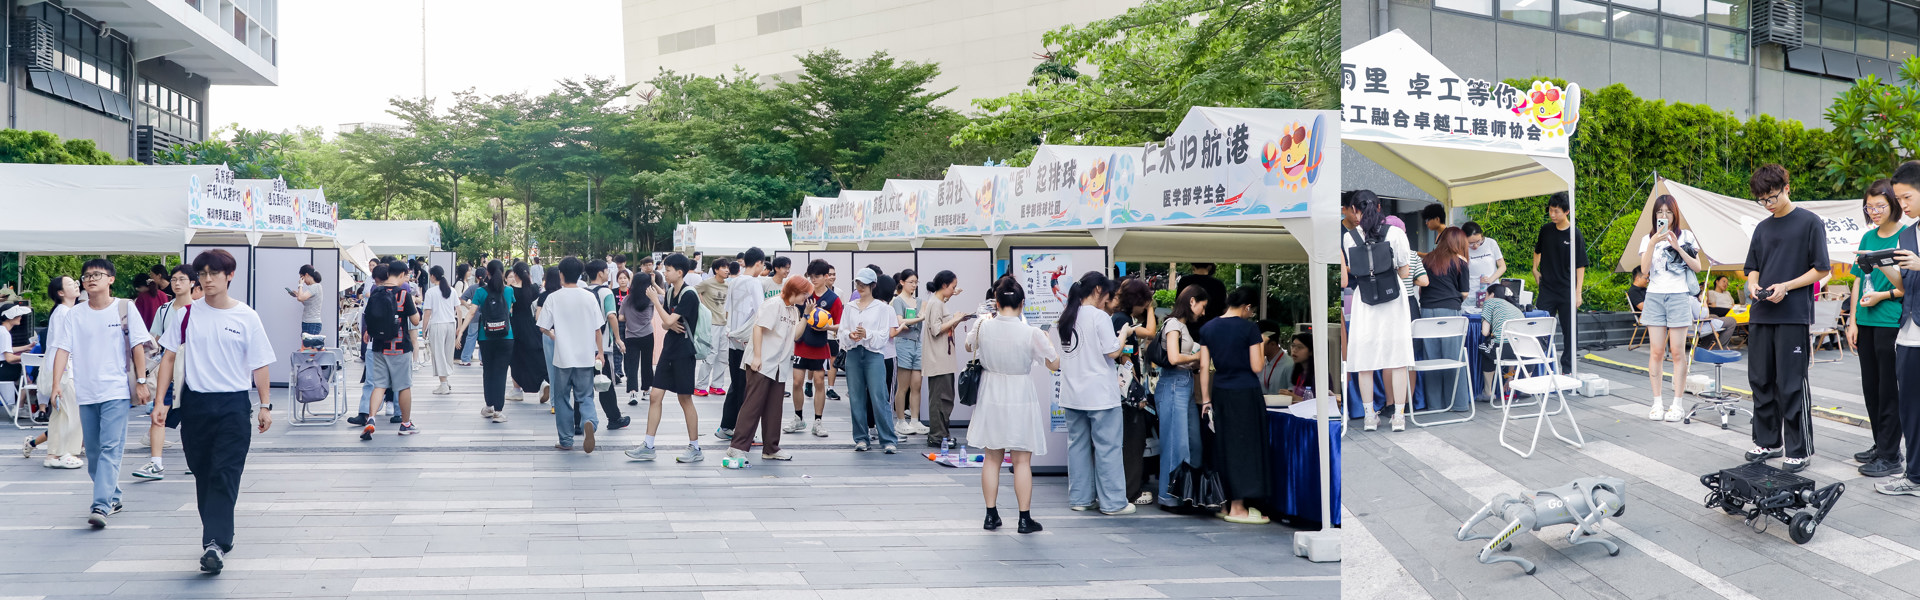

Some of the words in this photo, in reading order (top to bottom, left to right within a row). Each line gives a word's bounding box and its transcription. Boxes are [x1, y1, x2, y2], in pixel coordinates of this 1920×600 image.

[1407, 72, 1517, 110] 卓工等你
[1341, 103, 1542, 141] 工融合卓越工程师协会
[1141, 123, 1250, 177] 仁术归航港
[937, 179, 963, 207] 医羽社
[1163, 183, 1226, 207] 医学部学生会
[933, 212, 966, 227] 医学部羽毛球社团
[1020, 200, 1061, 219] 医学部排球社团
[1821, 217, 1859, 232] 给站
